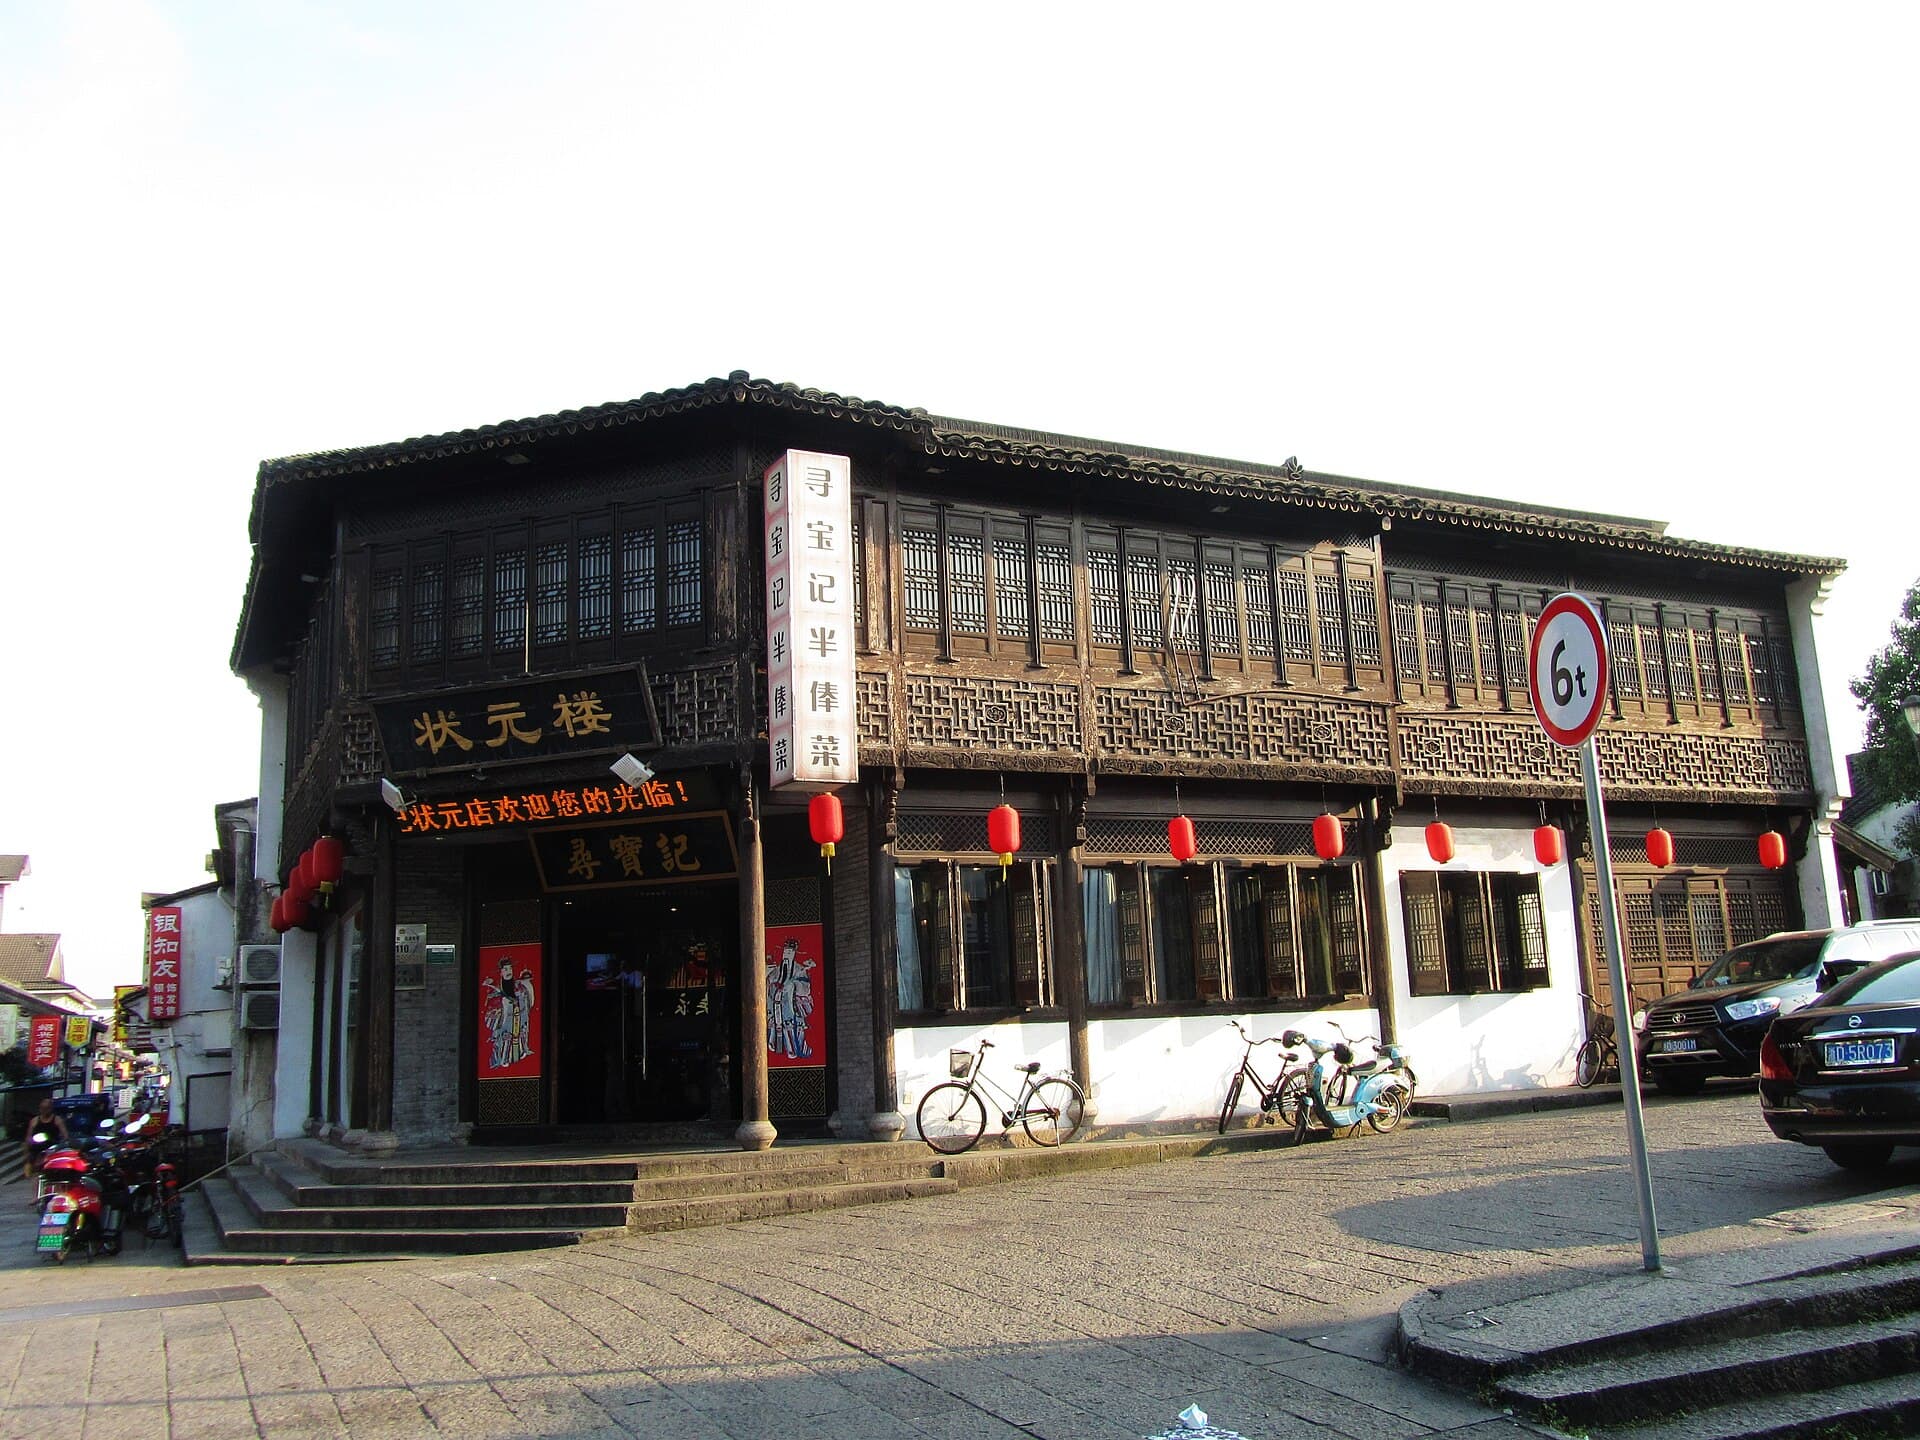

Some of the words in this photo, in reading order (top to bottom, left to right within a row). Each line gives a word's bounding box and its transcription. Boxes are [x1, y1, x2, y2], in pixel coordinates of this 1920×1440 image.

[768, 471, 788, 772] 寻宝记半俸菜
[804, 465, 841, 768] 寻宝记半俸菜
[1550, 640, 1587, 706] 6t
[414, 690, 612, 754] 状元楼
[567, 832, 701, 880] 尋寶記
[153, 914, 180, 977] 银知友
